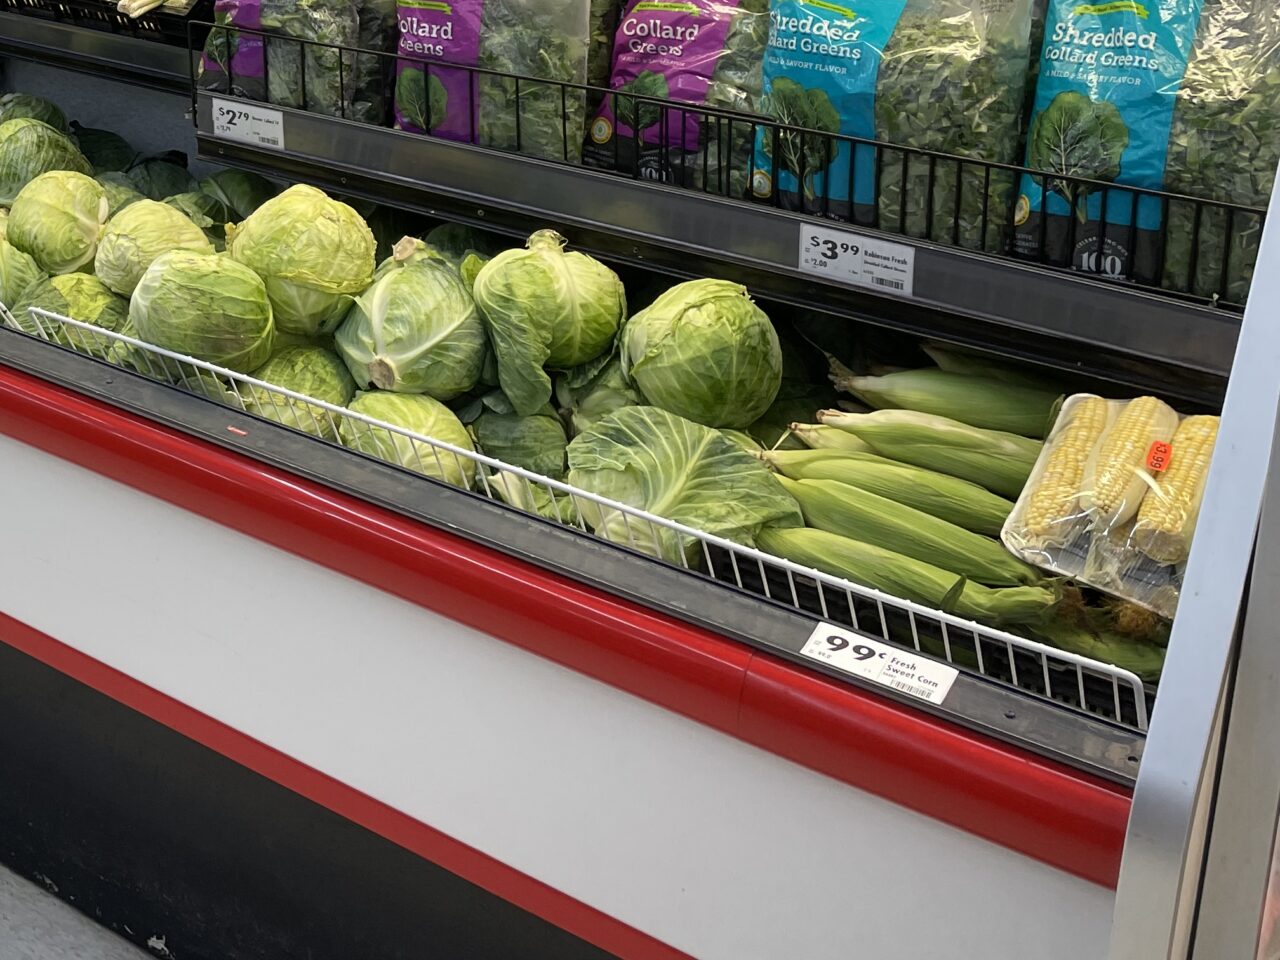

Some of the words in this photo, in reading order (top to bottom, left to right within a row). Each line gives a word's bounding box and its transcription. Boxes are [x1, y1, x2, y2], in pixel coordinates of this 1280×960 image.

[398, 15, 454, 40] ollard
[623, 18, 699, 41] Collard
[1052, 21, 1158, 51] Shredded
[801, 38, 862, 60] Greens
[1045, 45, 1098, 67] Collard
[1100, 51, 1160, 71] Greens
[814, 62, 847, 74] FLAVOR
[890, 657, 917, 671] Fresh
[886, 664, 915, 680] Sweet
[917, 675, 939, 689] Corn
